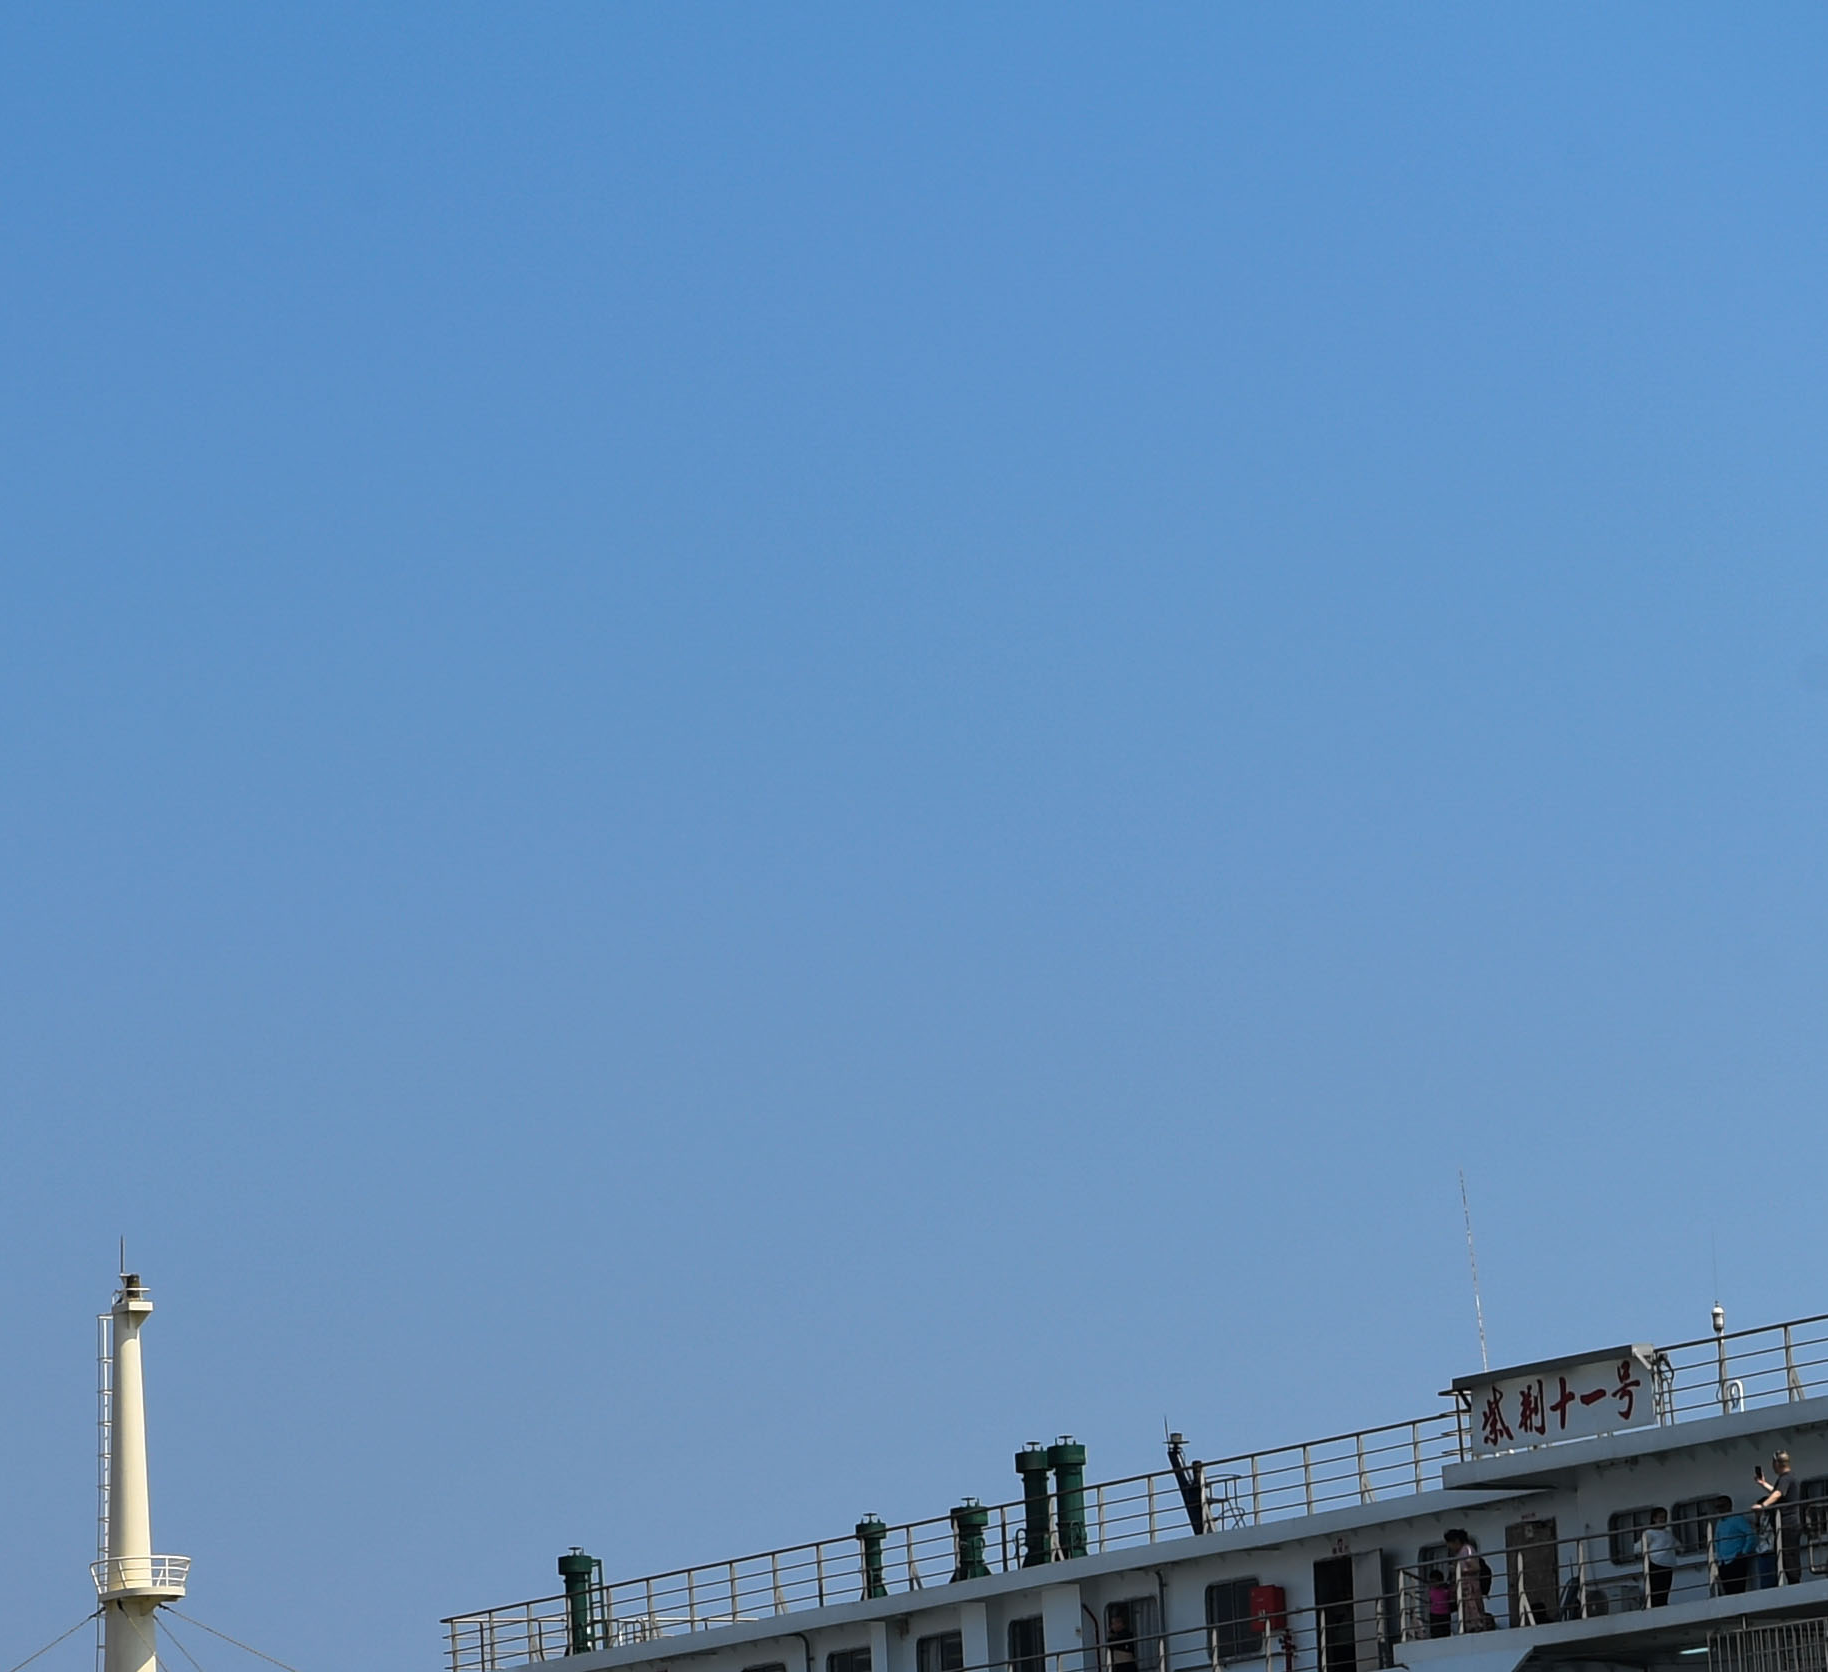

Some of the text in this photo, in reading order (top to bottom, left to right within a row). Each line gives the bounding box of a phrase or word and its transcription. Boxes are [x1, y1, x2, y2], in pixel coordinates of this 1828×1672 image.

[1482, 1360, 1641, 1446] 紫荆十一号
